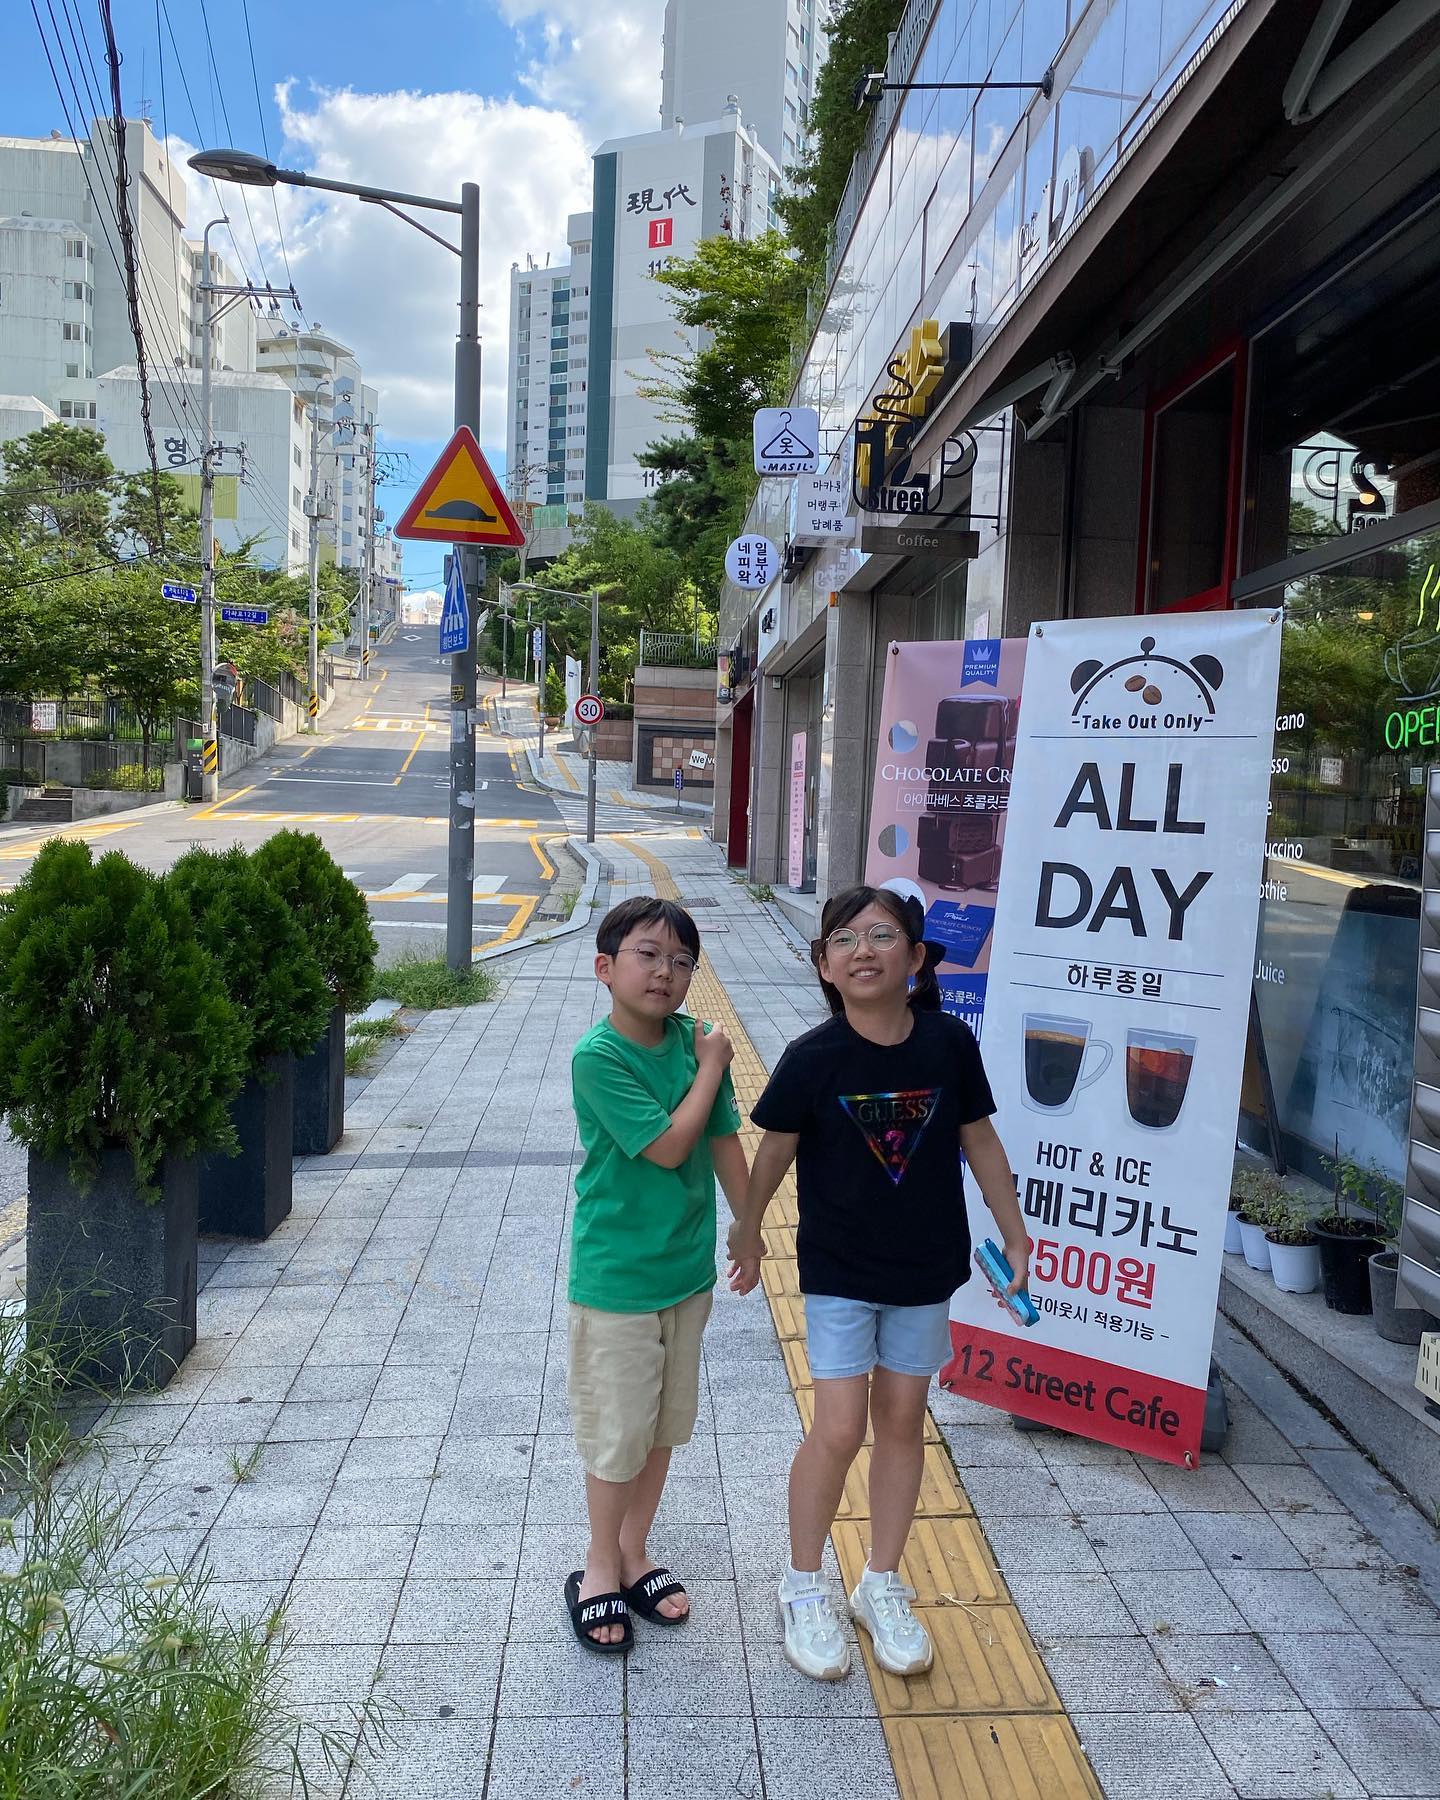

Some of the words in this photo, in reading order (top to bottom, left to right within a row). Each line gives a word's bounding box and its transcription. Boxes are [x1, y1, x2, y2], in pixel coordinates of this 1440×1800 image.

[626, 184, 697, 215] 現代
[779, 437, 794, 455] 옷
[807, 500, 841, 513] 머랭쿠
[868, 486, 930, 513] Street
[811, 519, 844, 532] 답례품
[737, 542, 768, 556] 네일
[897, 534, 939, 548] Coffee
[737, 557, 769, 570] 피부
[737, 570, 767, 585] 왁싱
[964, 663, 997, 671] PREMIUM
[581, 703, 598, 718] 30
[1128, 714, 1157, 729] Out
[881, 764, 982, 782] CHOCOLATE
[1053, 762, 1206, 835] ALL
[1034, 860, 1214, 942] DAY
[1067, 963, 1163, 998] 하루종일
[1255, 960, 1286, 985] Juice
[858, 1099, 928, 1122] GUESS
[1036, 1140, 1082, 1172] HOT
[1088, 1151, 1105, 1177] &
[1114, 1155, 1152, 1187] ICE
[1093, 1310, 1155, 1341] 적용가능
[960, 1344, 995, 1382] 12
[1005, 1356, 1096, 1412] Street
[1105, 1386, 1180, 1436] Cafe
[581, 1601, 608, 1624] NEW
